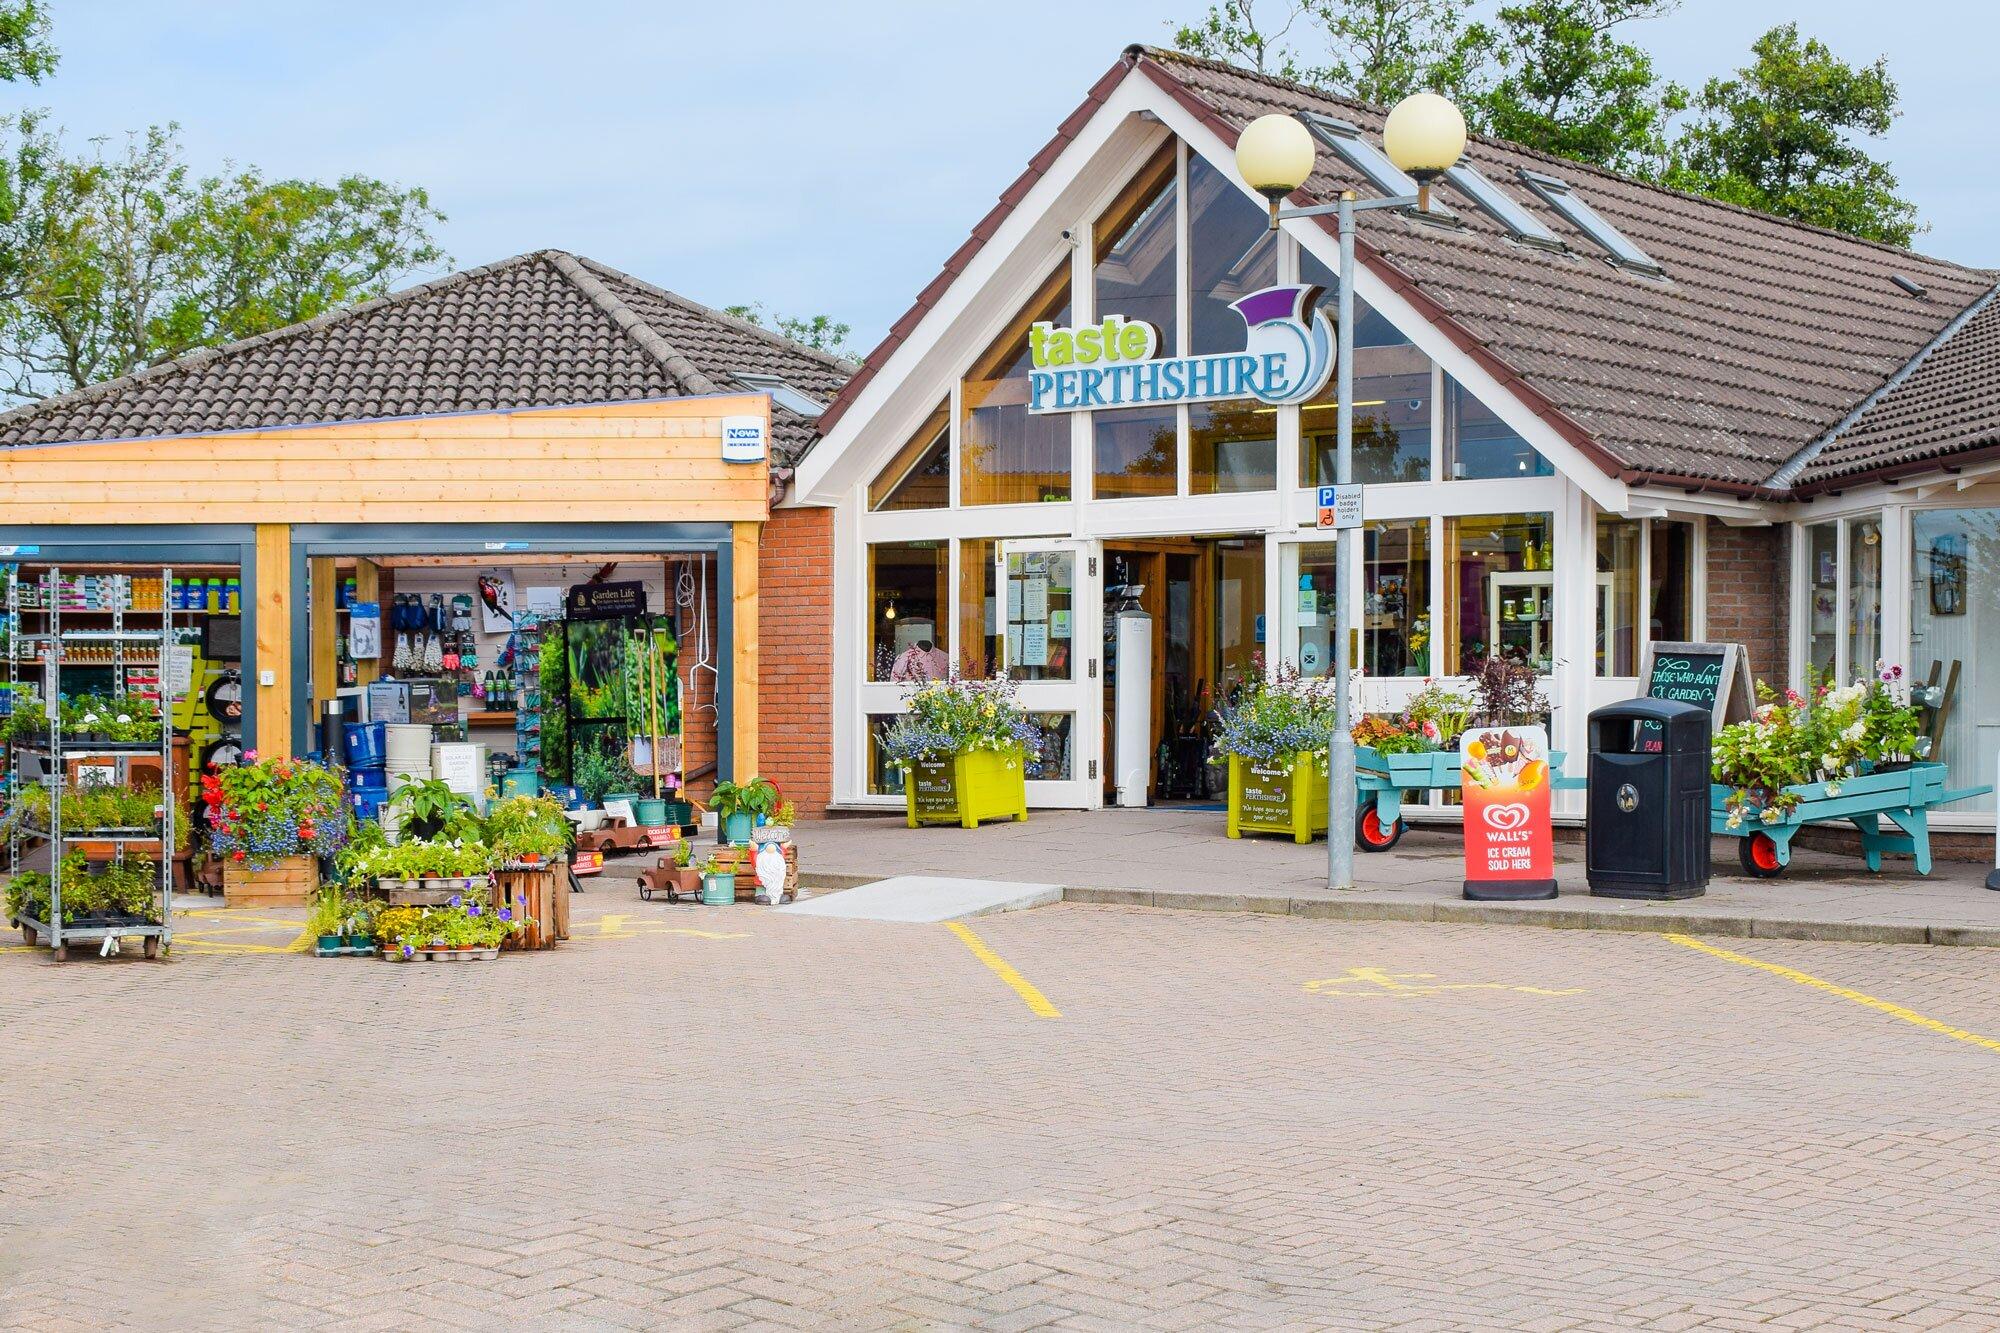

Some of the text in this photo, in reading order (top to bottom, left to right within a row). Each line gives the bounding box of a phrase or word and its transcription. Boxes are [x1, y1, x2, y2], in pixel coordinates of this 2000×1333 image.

[1029, 318, 1148, 367] taste
[1029, 352, 1289, 411] PERTHSHIRE
[728, 429, 758, 438] NOVA
[1323, 489, 1333, 506] P
[592, 587, 635, 600] Garden Life
[1652, 671, 1721, 685] THOSE WHO PLANT
[1667, 687, 1703, 701] GARDEN
[1250, 767, 1281, 776] Welcome
[1245, 787, 1263, 795] taste
[943, 797, 954, 805] enjoy
[1253, 805, 1264, 814] hope
[1265, 807, 1274, 815] you
[1275, 807, 1289, 816] enjoy
[1252, 814, 1264, 822] your
[1487, 847, 1531, 858] ICE CREAM
[1488, 858, 1532, 871] SOLD HERE
